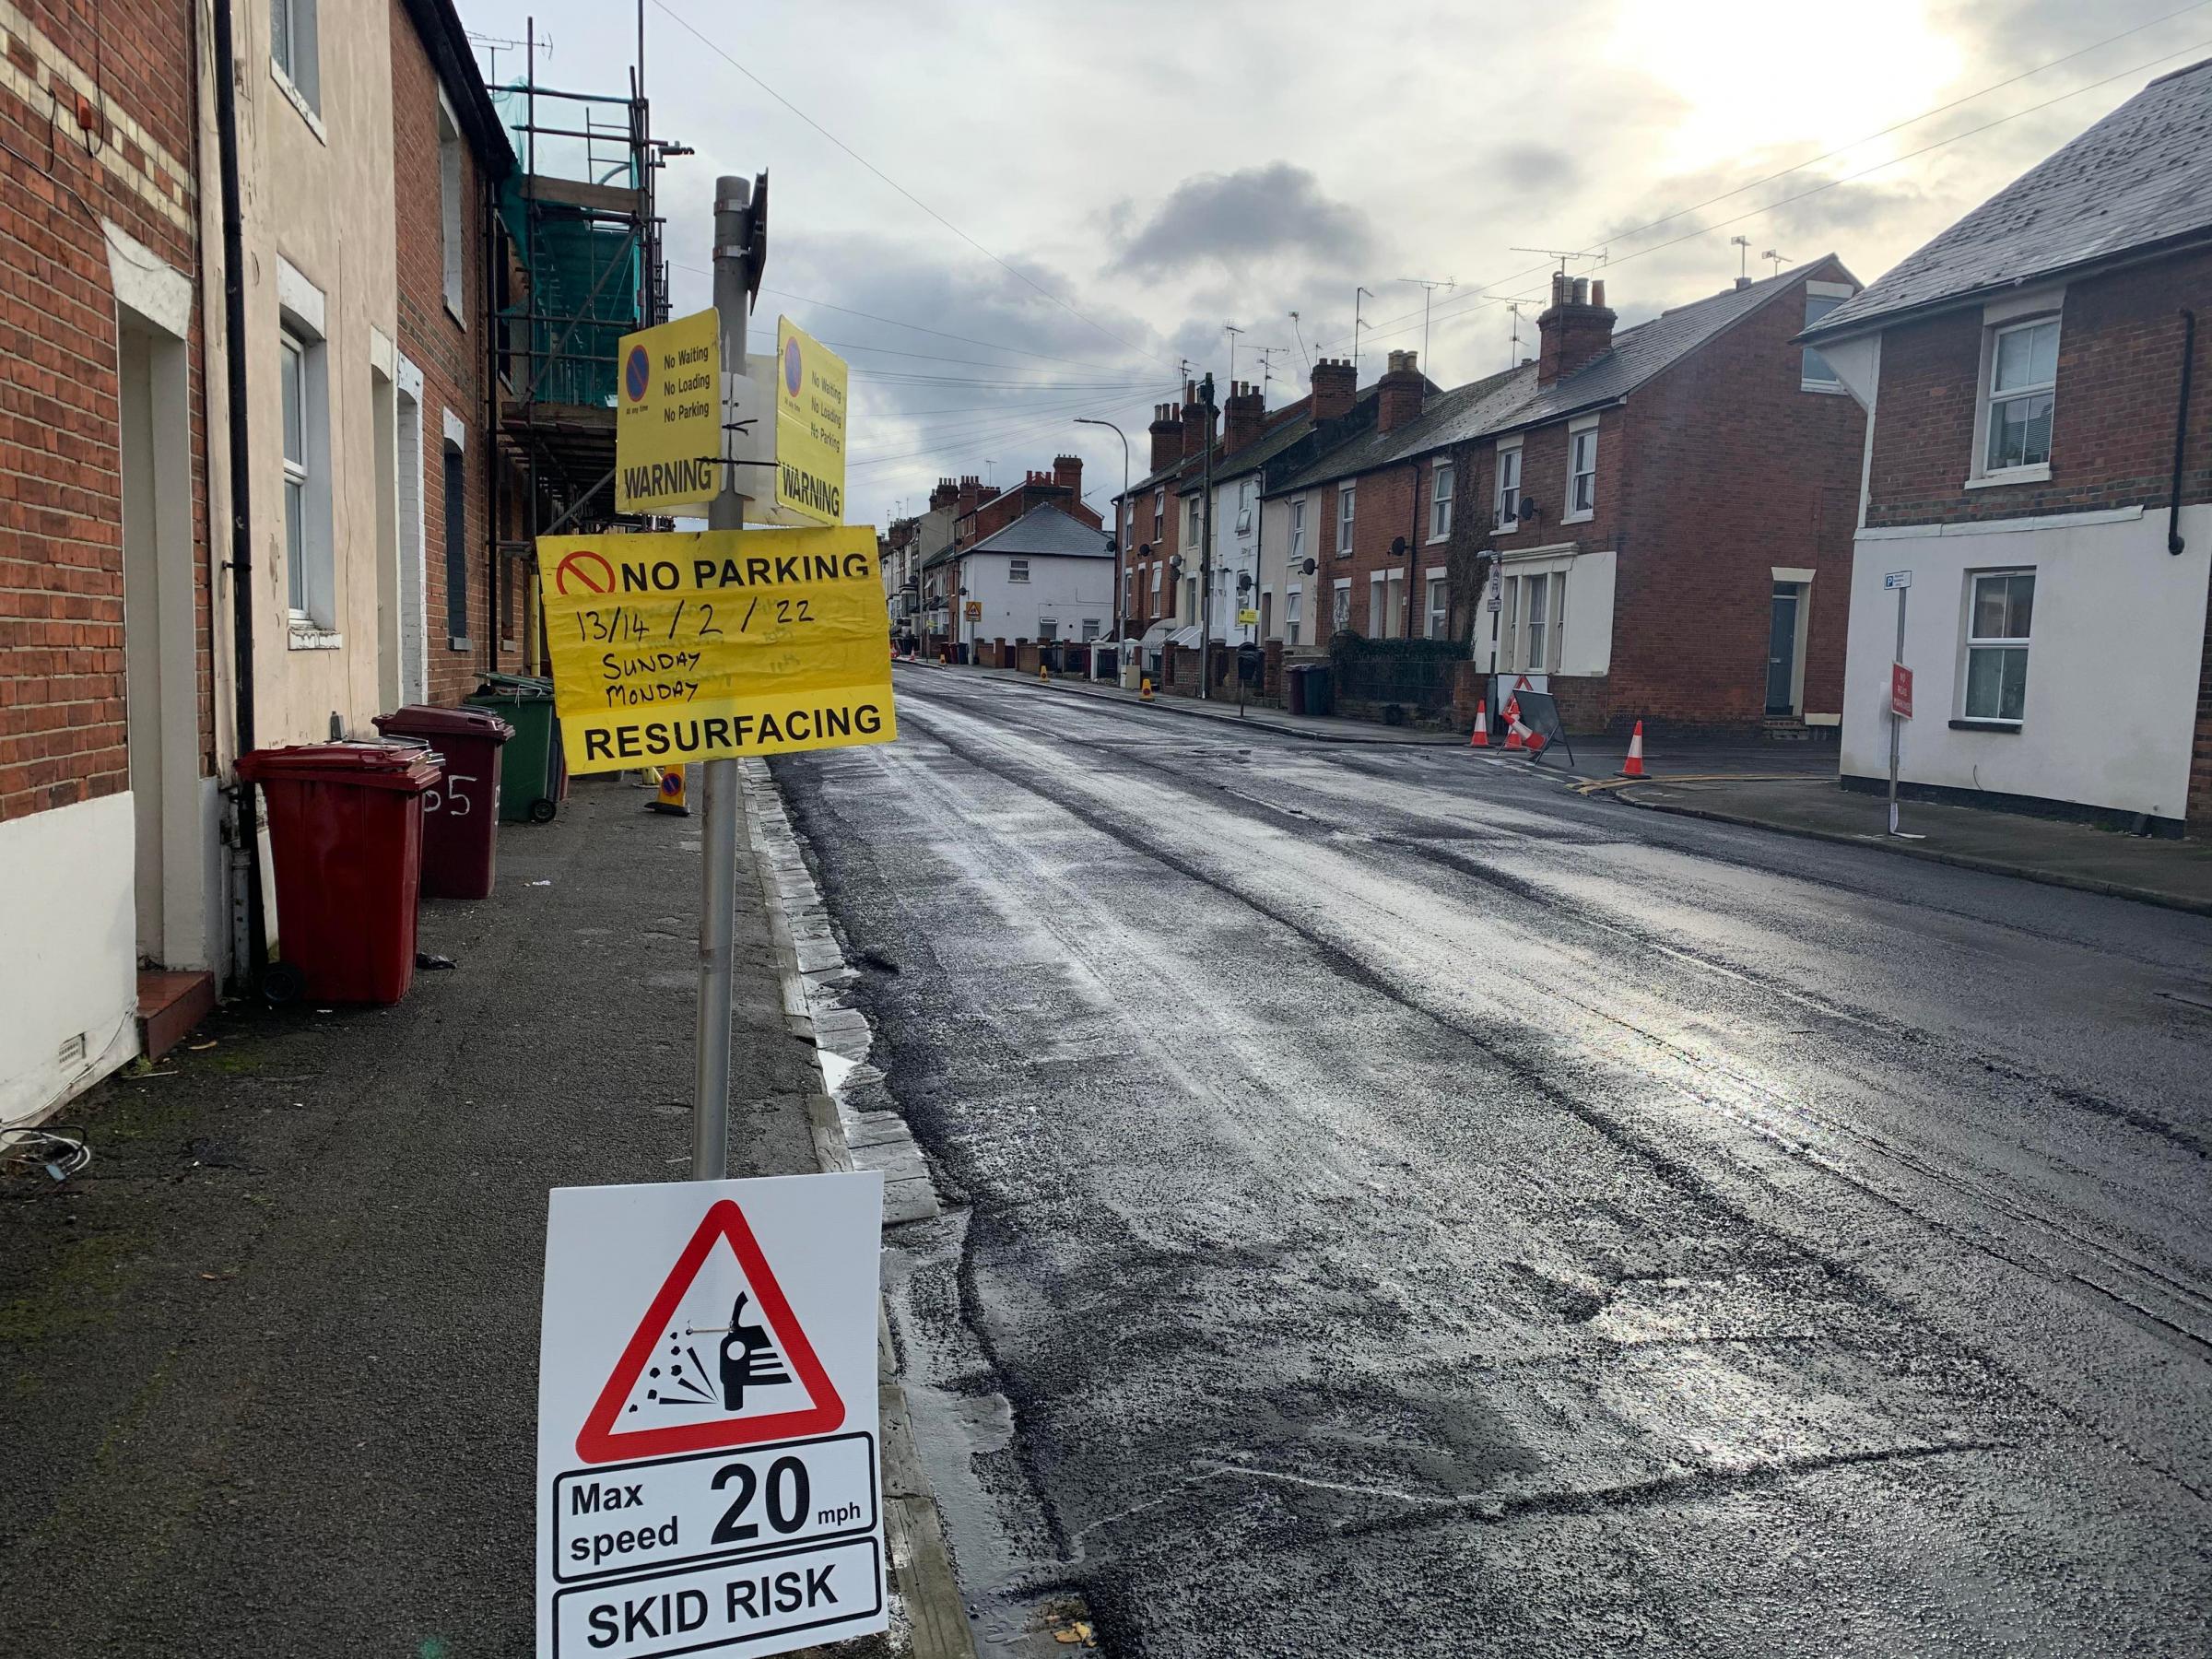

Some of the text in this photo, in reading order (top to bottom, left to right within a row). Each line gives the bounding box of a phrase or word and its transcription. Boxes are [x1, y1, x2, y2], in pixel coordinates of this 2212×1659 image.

[665, 347, 709, 370] No Waiting
[665, 373, 710, 396] No Loading
[812, 371, 841, 405] No Waiting
[665, 401, 709, 423] No Parking
[811, 395, 841, 429] No Loading
[811, 421, 840, 453] No Parking
[624, 457, 712, 500] WARNING
[782, 465, 841, 517] WARNING
[621, 553, 869, 592] NO PARKING
[699, 605, 724, 637] 2
[777, 599, 816, 623] 22
[602, 652, 700, 680] SUNDAY
[606, 681, 699, 708] MONDAY
[584, 704, 882, 761] RESURFACING
[571, 1483, 644, 1516] Max
[710, 1455, 861, 1545] 20 mph
[570, 1515, 678, 1566] speed
[586, 1564, 840, 1649] SKID RISK
